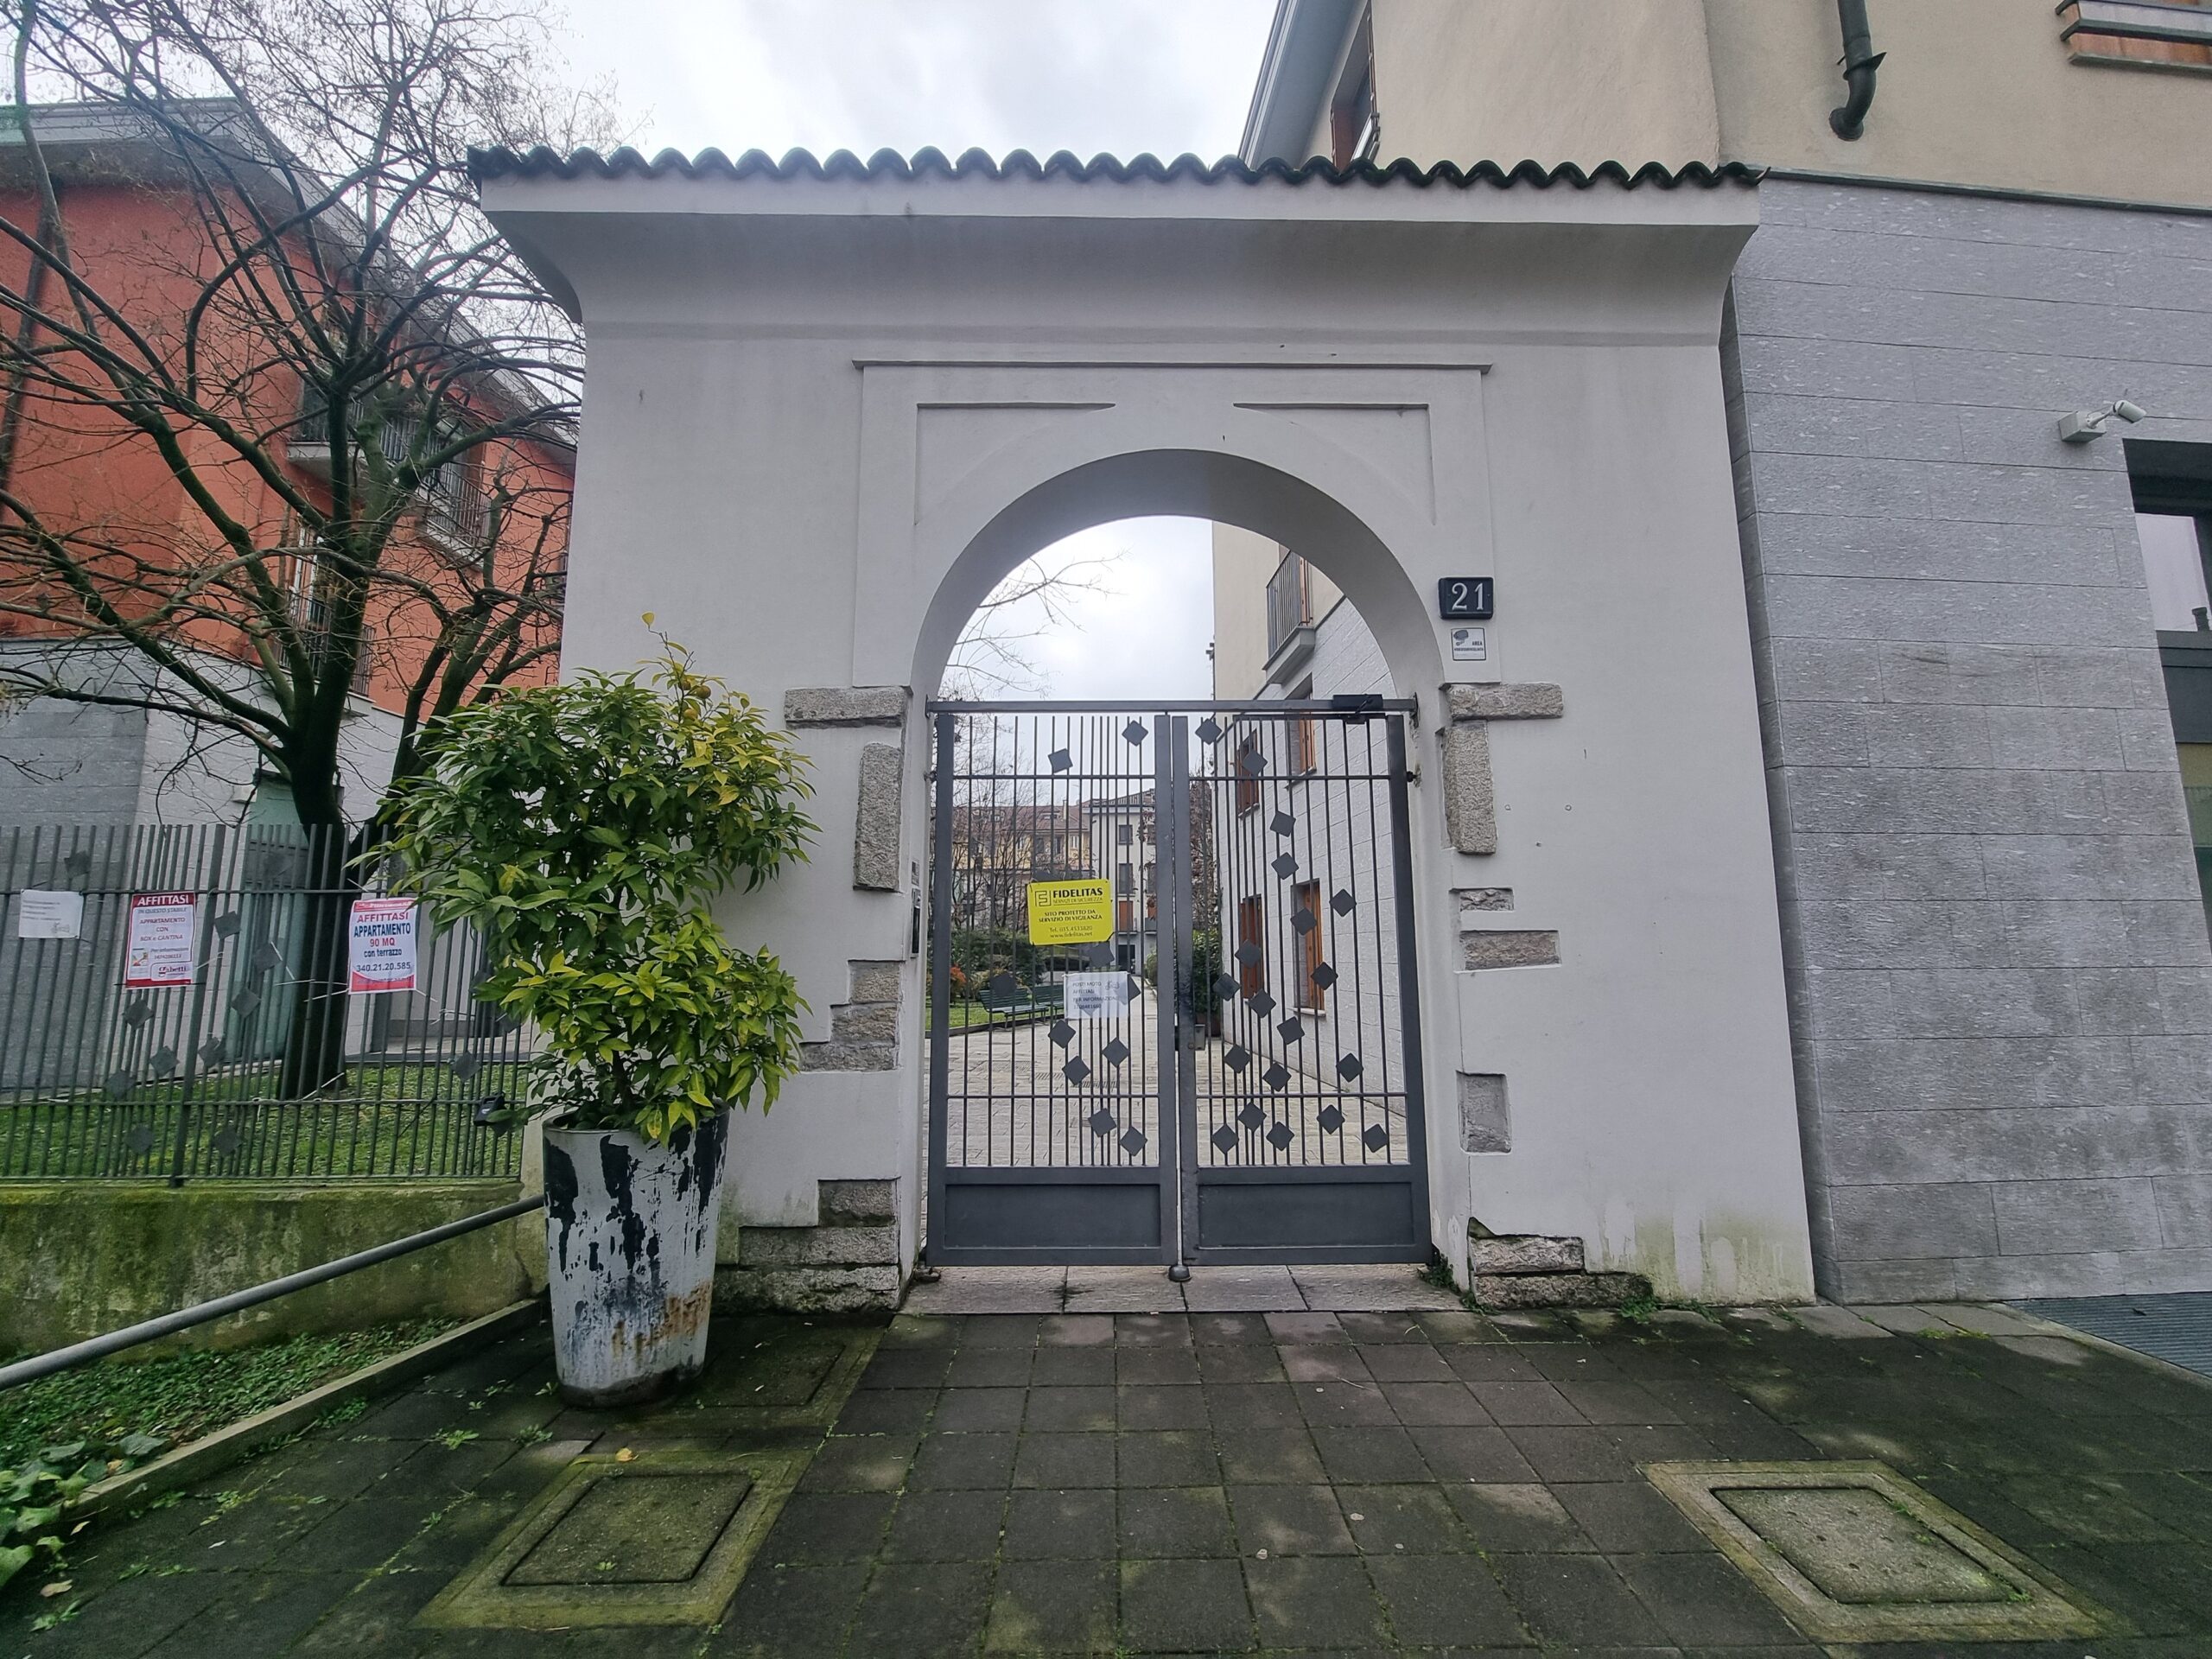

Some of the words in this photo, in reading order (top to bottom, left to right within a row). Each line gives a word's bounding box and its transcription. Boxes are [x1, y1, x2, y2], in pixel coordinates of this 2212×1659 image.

[1452, 582, 1484, 610] 21
[1052, 887, 1103, 899] FIDELITAS
[137, 894, 189, 906] AFFITTASI
[357, 912, 409, 923] AFFITTASI
[353, 923, 411, 938] APPARTAMENTO
[370, 938, 379, 947] 90
[382, 938, 396, 946] MQ
[356, 962, 411, 972] 340.21.20.585
